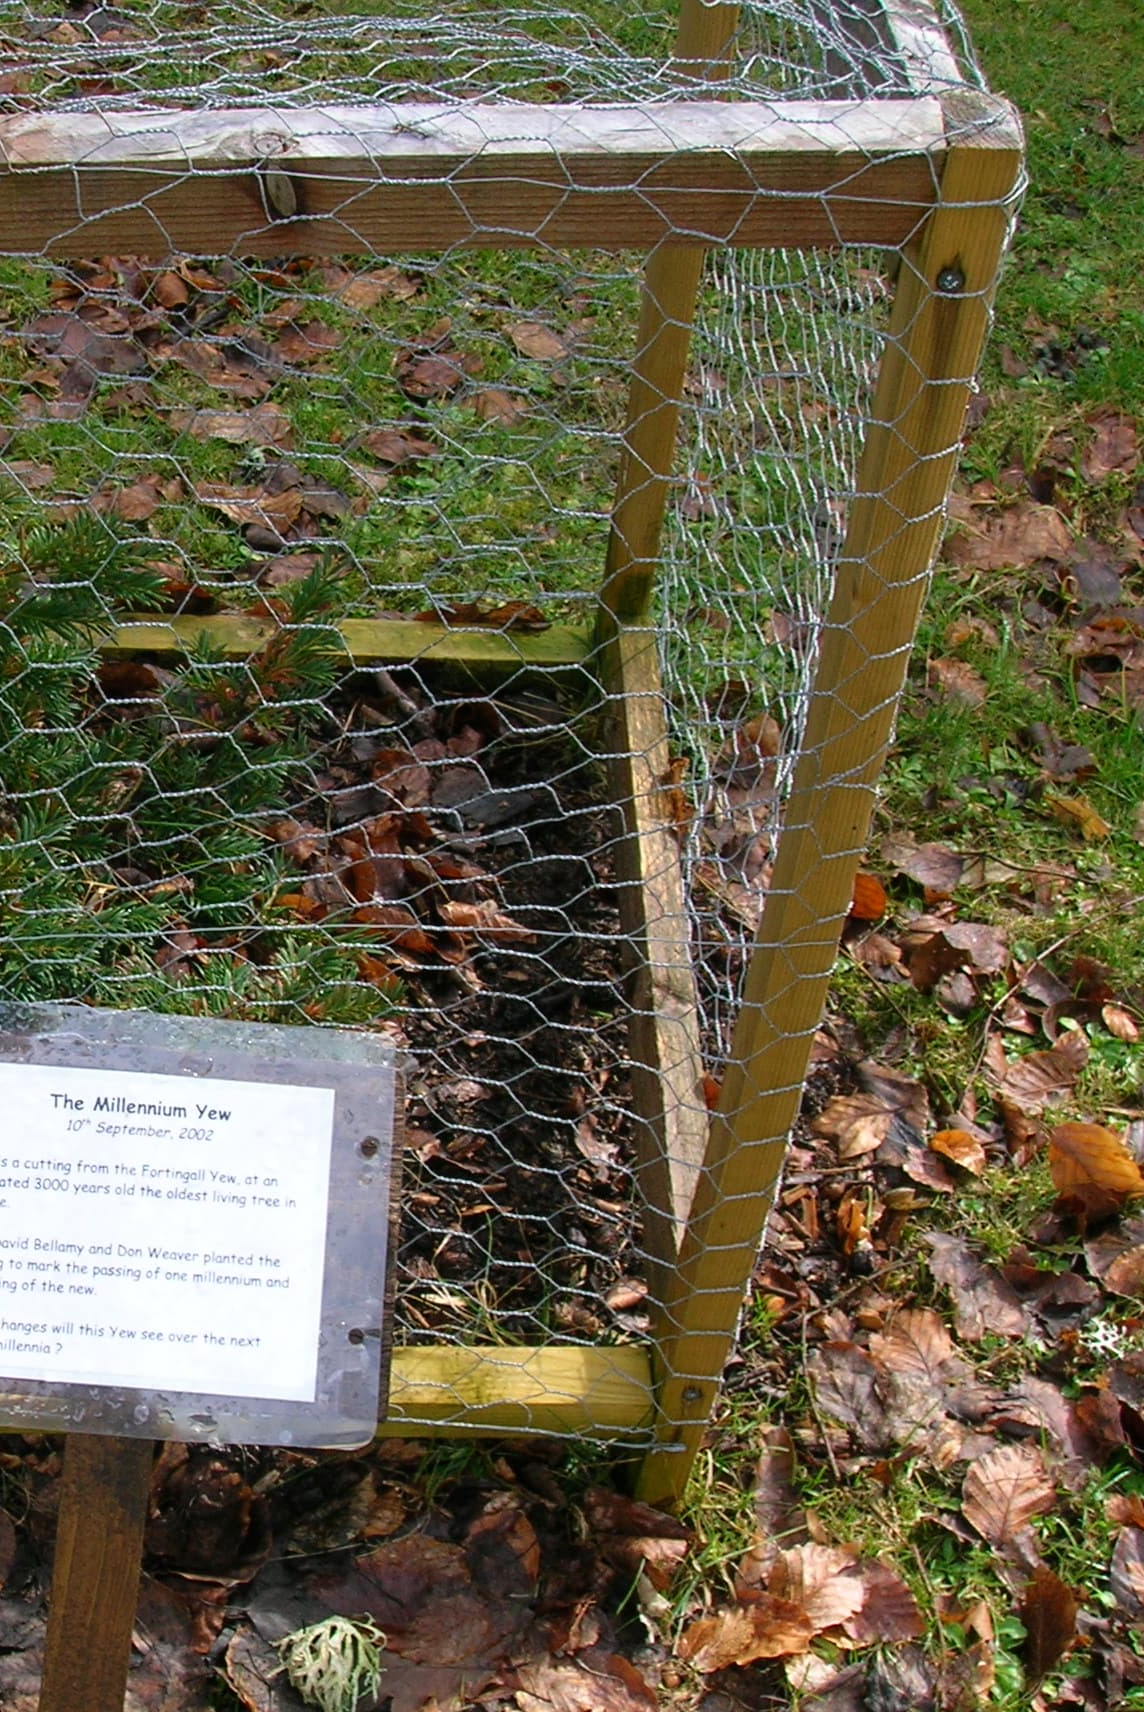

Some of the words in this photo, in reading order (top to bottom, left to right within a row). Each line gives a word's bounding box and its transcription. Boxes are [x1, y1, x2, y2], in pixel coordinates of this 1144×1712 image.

[50, 1093, 84, 1111] The
[93, 1096, 187, 1118] Millennium
[195, 1104, 232, 1121] Yew
[178, 1128, 214, 1141] 2002
[12, 1159, 20, 1168] a
[24, 1160, 72, 1176] cutting
[77, 1160, 109, 1174] from
[115, 1164, 136, 1176] the
[141, 1164, 205, 1184] Fortingall
[244, 1174, 259, 1186] at
[262, 1177, 279, 1187] an
[34, 1177, 70, 1192] 3000
[73, 1183, 110, 1196] years
[115, 1183, 135, 1196] old
[140, 1185, 162, 1198] the
[166, 1187, 207, 1201] oldest
[213, 1191, 247, 1208] living
[252, 1196, 280, 1207] tree
[285, 1197, 297, 1208] in
[34, 1238, 85, 1256] Bellamy
[88, 1244, 112, 1255] and
[117, 1244, 142, 1257] Don
[148, 1247, 199, 1261] Weaver
[204, 1252, 253, 1268] planted
[259, 1255, 280, 1267] the
[9, 1259, 23, 1270] to
[27, 1260, 60, 1272] mark
[66, 1262, 88, 1274] the
[93, 1266, 141, 1282] passing
[146, 1267, 160, 1279] of
[165, 1272, 187, 1281] one
[193, 1272, 261, 1286] millennium
[266, 1276, 289, 1288] and
[21, 1278, 37, 1291] of
[42, 1280, 64, 1294] the
[52, 1322, 74, 1334] will
[79, 1324, 104, 1337] this
[109, 1326, 136, 1339] Yew
[141, 1331, 163, 1341] see
[168, 1334, 198, 1343] over
[203, 1333, 225, 1345] the
[230, 1337, 260, 1347] next
[55, 1341, 63, 1354] ?
